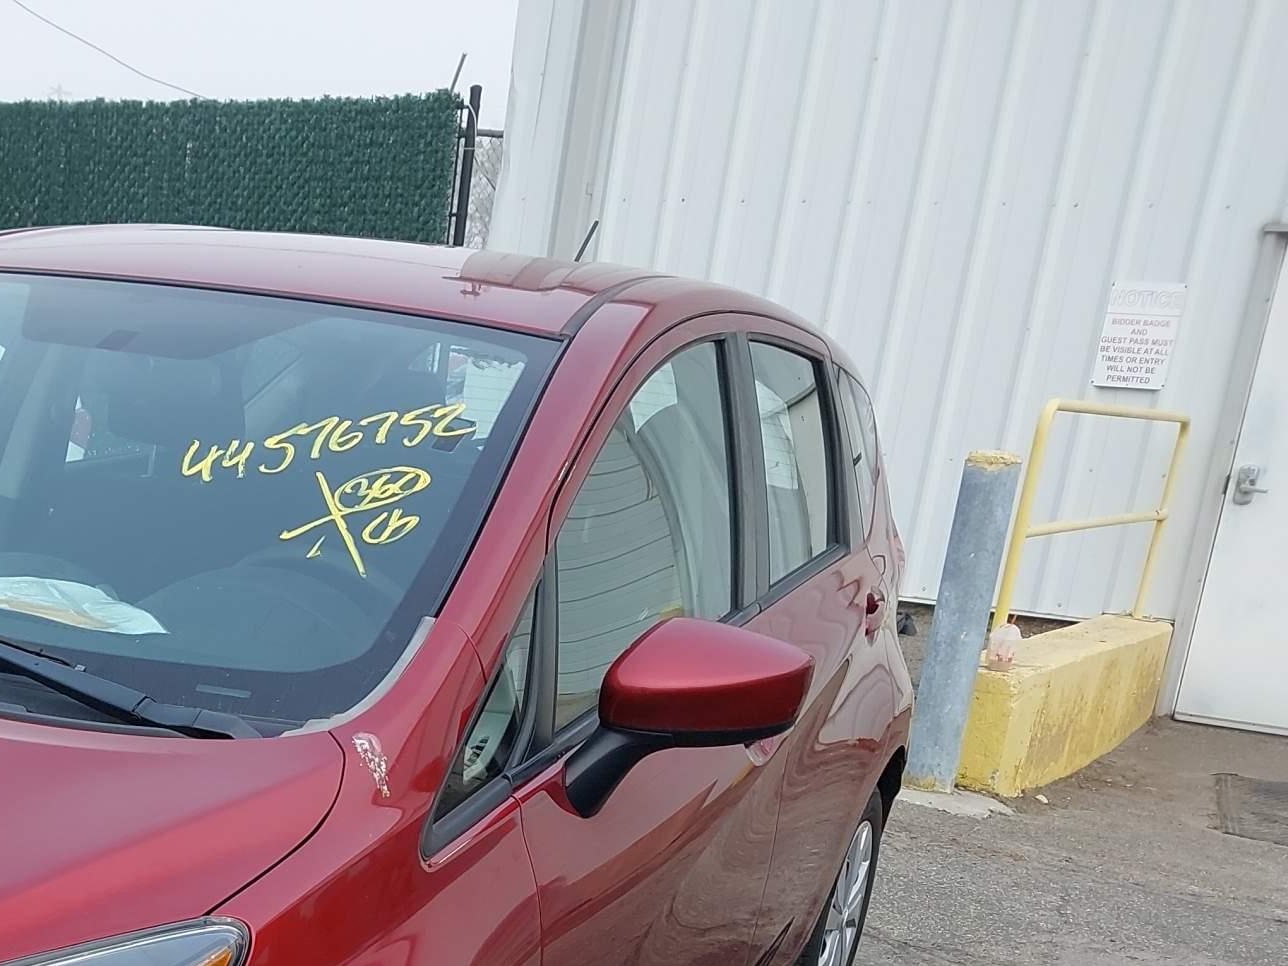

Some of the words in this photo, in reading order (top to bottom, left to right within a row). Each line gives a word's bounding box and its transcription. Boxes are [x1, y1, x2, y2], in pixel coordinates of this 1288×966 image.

[1111, 318, 1141, 326] BIDDER
[1143, 319, 1171, 327] BADGE
[1130, 328, 1148, 336] AND
[1101, 336, 1128, 344] GUEST
[1099, 345, 1111, 353] BE
[1154, 348, 1169, 356] ALL
[1101, 355, 1124, 363] TIMES
[1139, 357, 1165, 365] ENTRY
[1106, 365, 1125, 373] WILL
[1105, 374, 1151, 384] PERMITTED
[182, 403, 477, 482] 44576752
